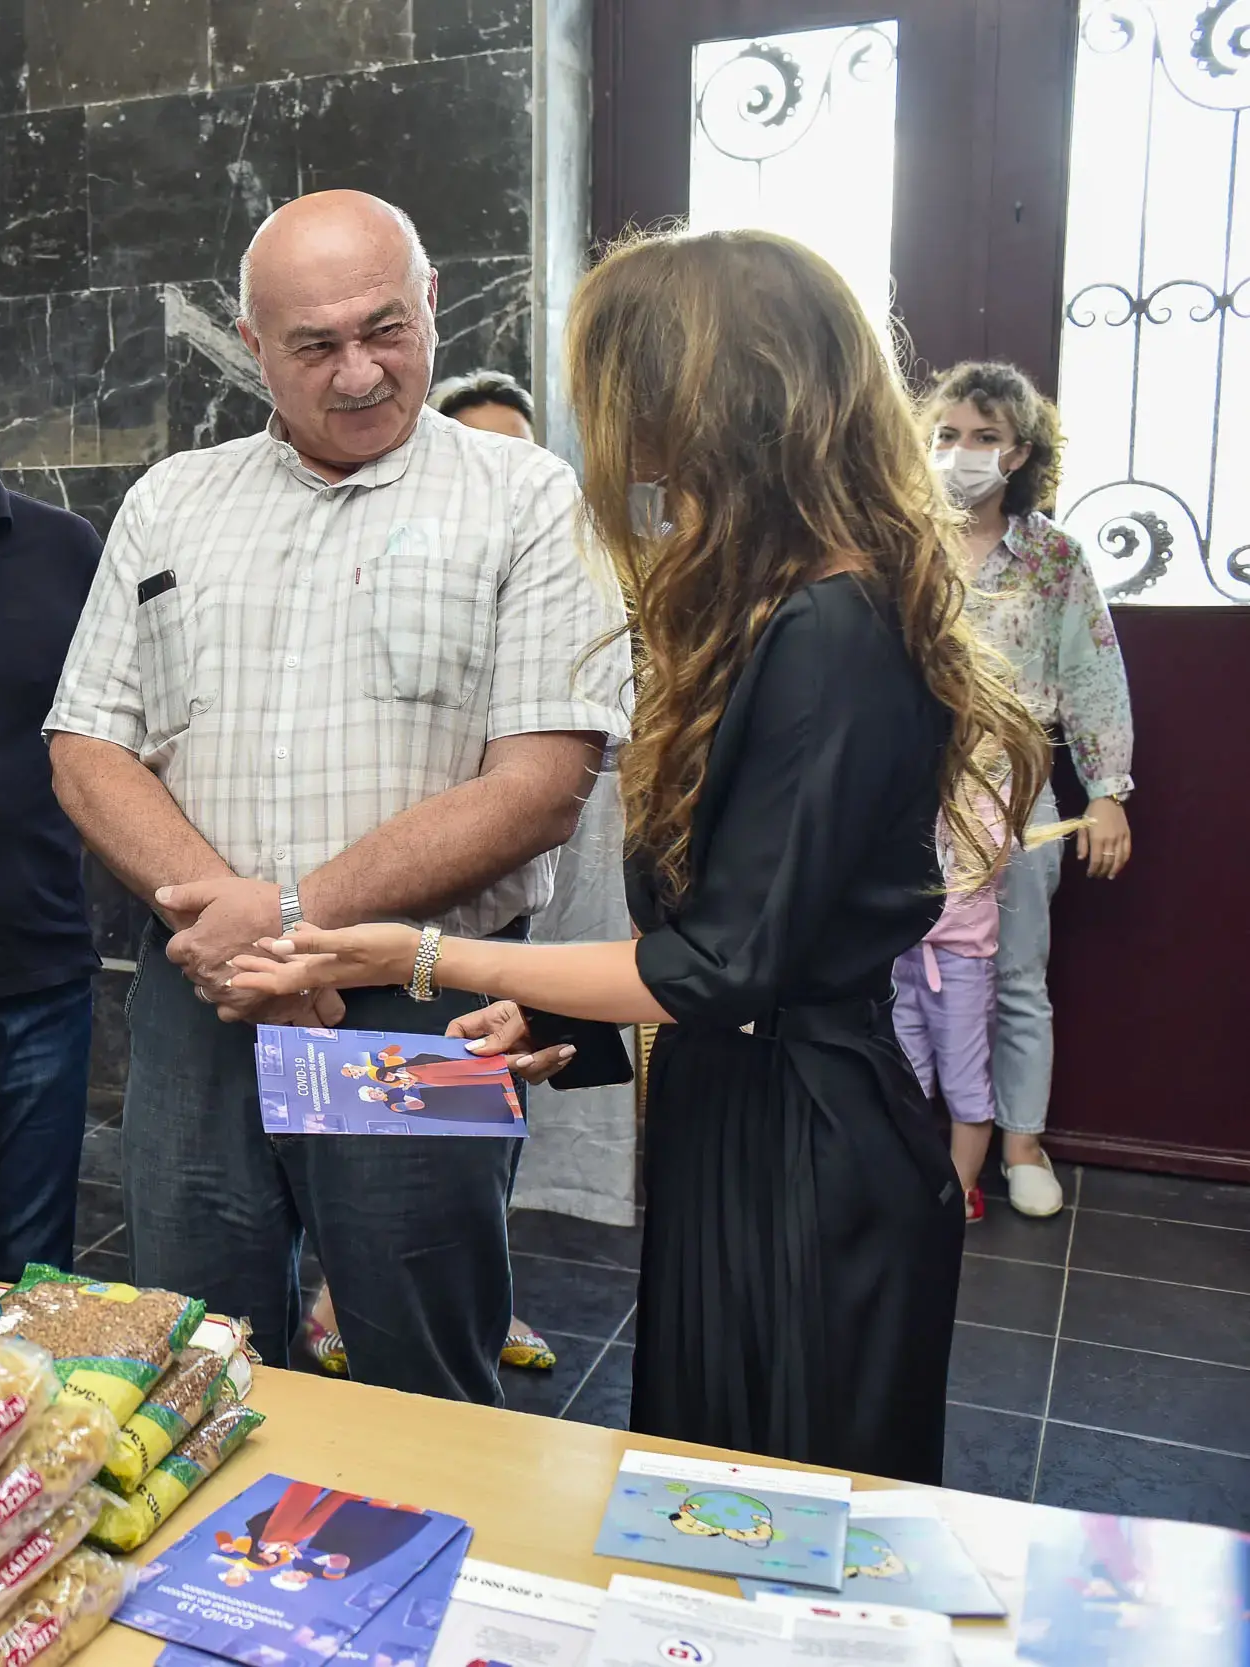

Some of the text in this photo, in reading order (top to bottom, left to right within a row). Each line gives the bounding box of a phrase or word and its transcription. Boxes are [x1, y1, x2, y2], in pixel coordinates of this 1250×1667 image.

[294, 1057, 309, 1096] COVID-19
[0, 1536, 51, 1581] KARMEN
[177, 1599, 255, 1630] COVID-19
